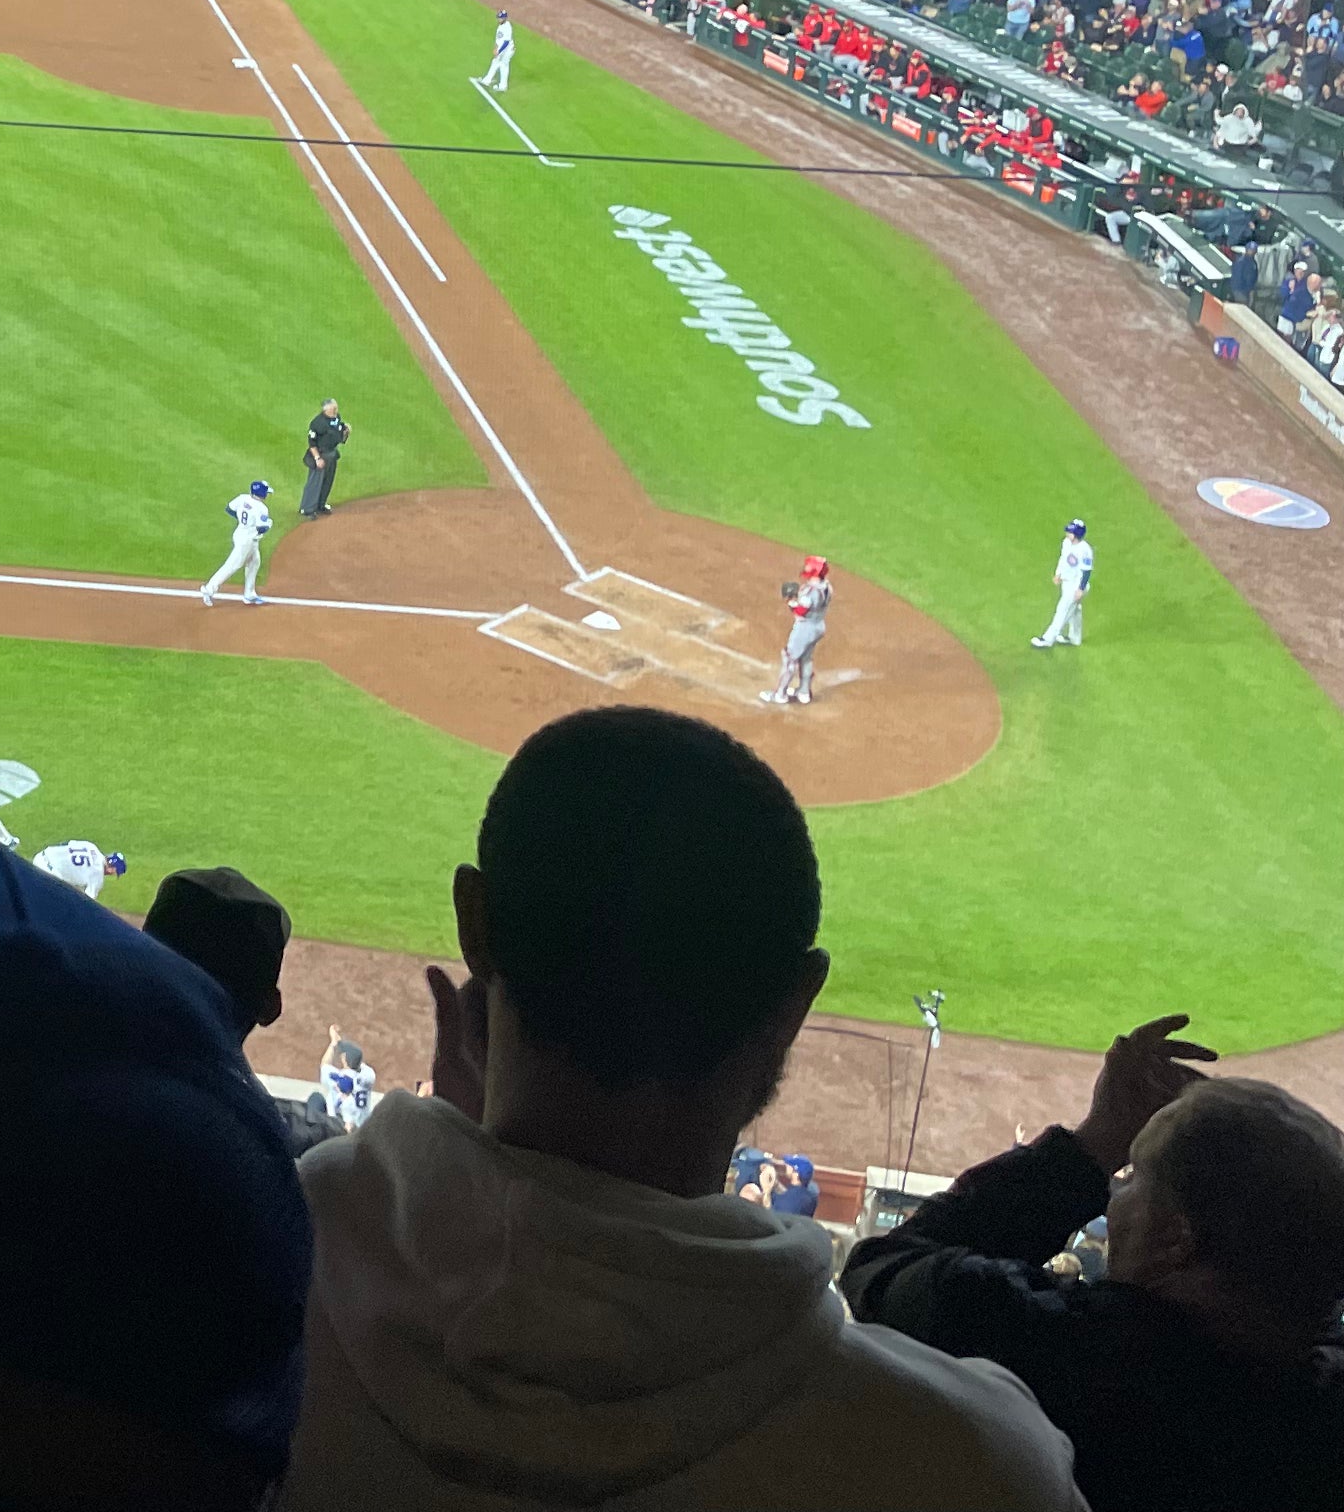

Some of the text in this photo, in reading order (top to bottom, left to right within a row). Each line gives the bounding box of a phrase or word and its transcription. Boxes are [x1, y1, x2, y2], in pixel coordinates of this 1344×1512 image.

[612, 225, 872, 429] Southwest
[241, 511, 248, 526] 8
[68, 847, 92, 868] 15
